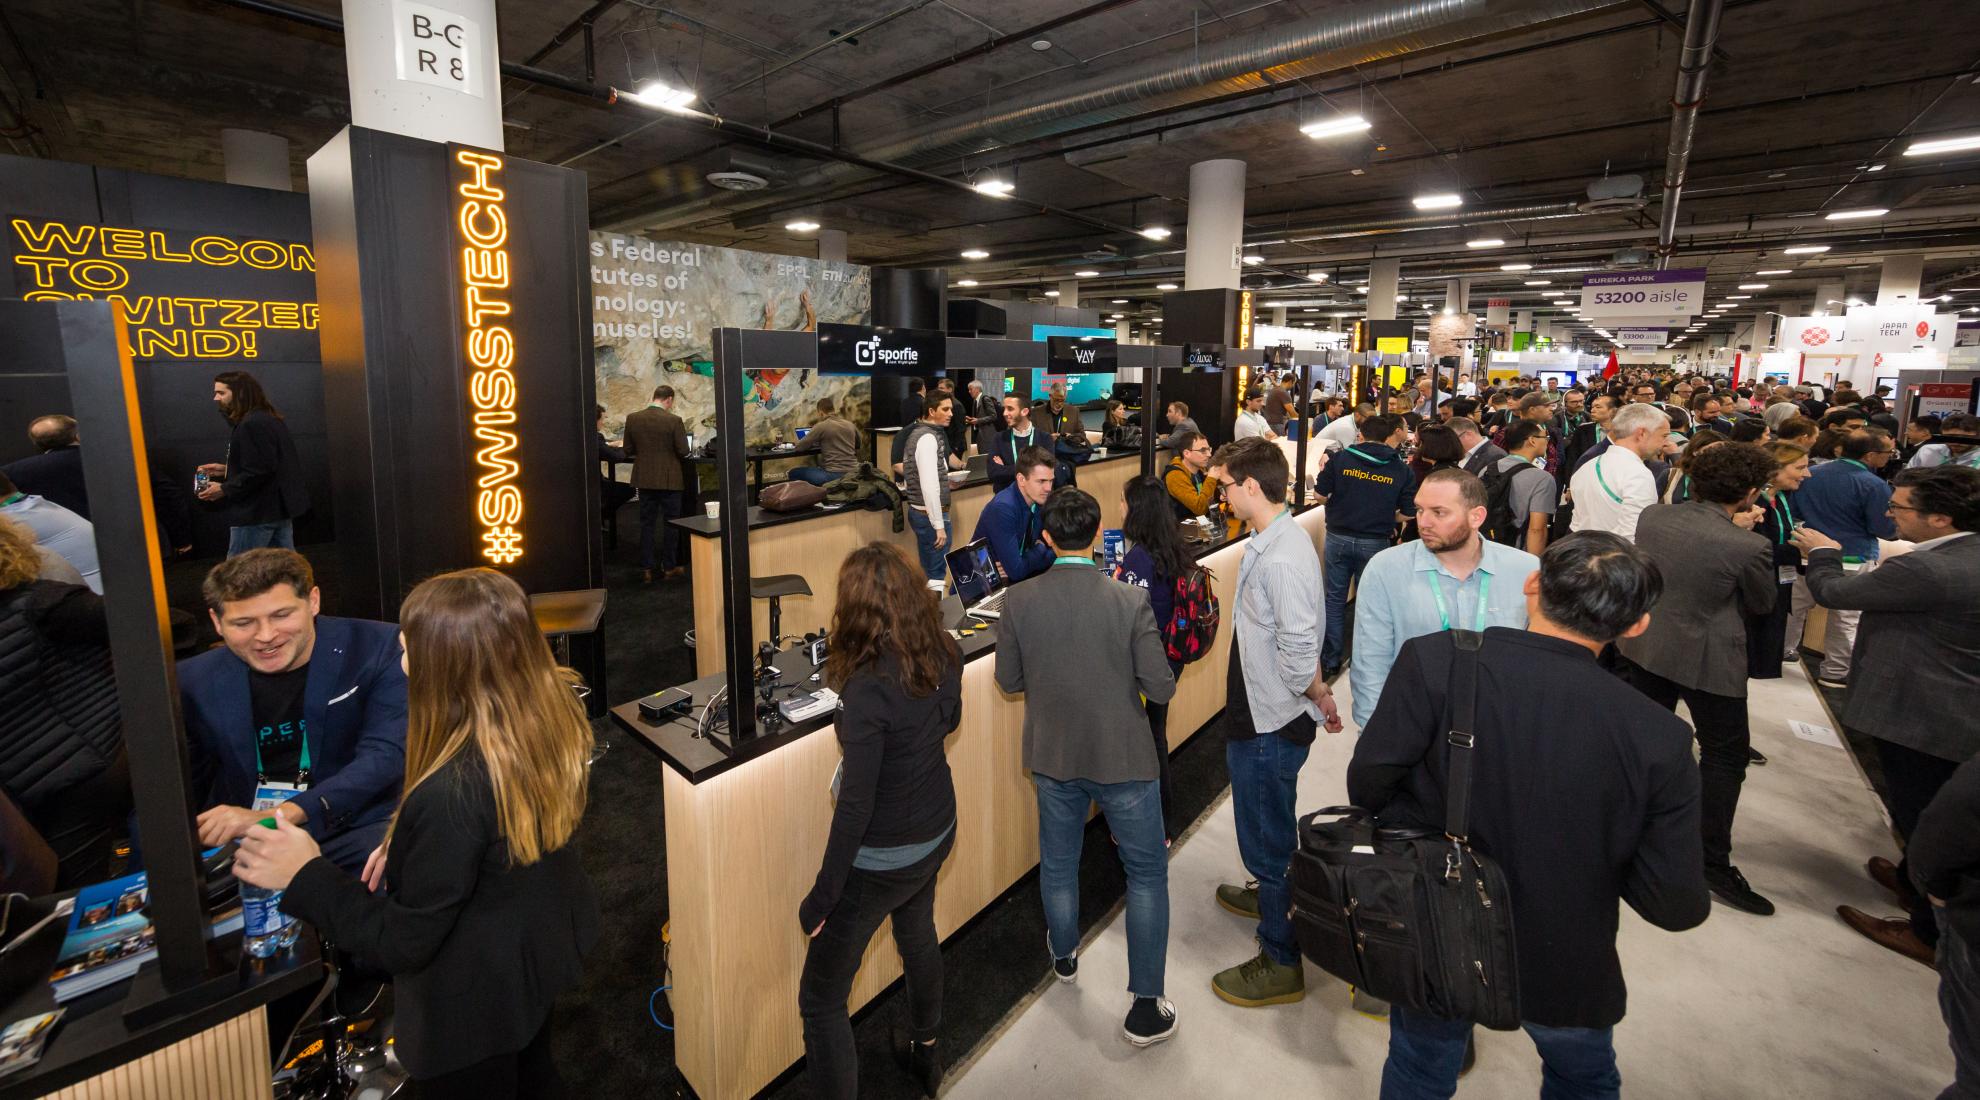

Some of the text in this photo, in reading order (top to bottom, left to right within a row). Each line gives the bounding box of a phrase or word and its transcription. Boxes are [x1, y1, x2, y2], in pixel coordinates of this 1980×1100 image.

[418, 48, 465, 81] R 8
[611, 238, 701, 267] Federal
[15, 255, 129, 291] TO
[590, 264, 689, 290] tutes of
[1588, 276, 1626, 284] EUREKA
[595, 291, 686, 319] nology:
[1594, 289, 1688, 304] 53200 aisle
[1880, 322, 1908, 330] JAPAN
[1880, 329, 1901, 337] TECH
[456, 150, 524, 563] #SWISSTECH
[878, 347, 919, 365] sporfie
[1343, 468, 1393, 485] mitipi.com
